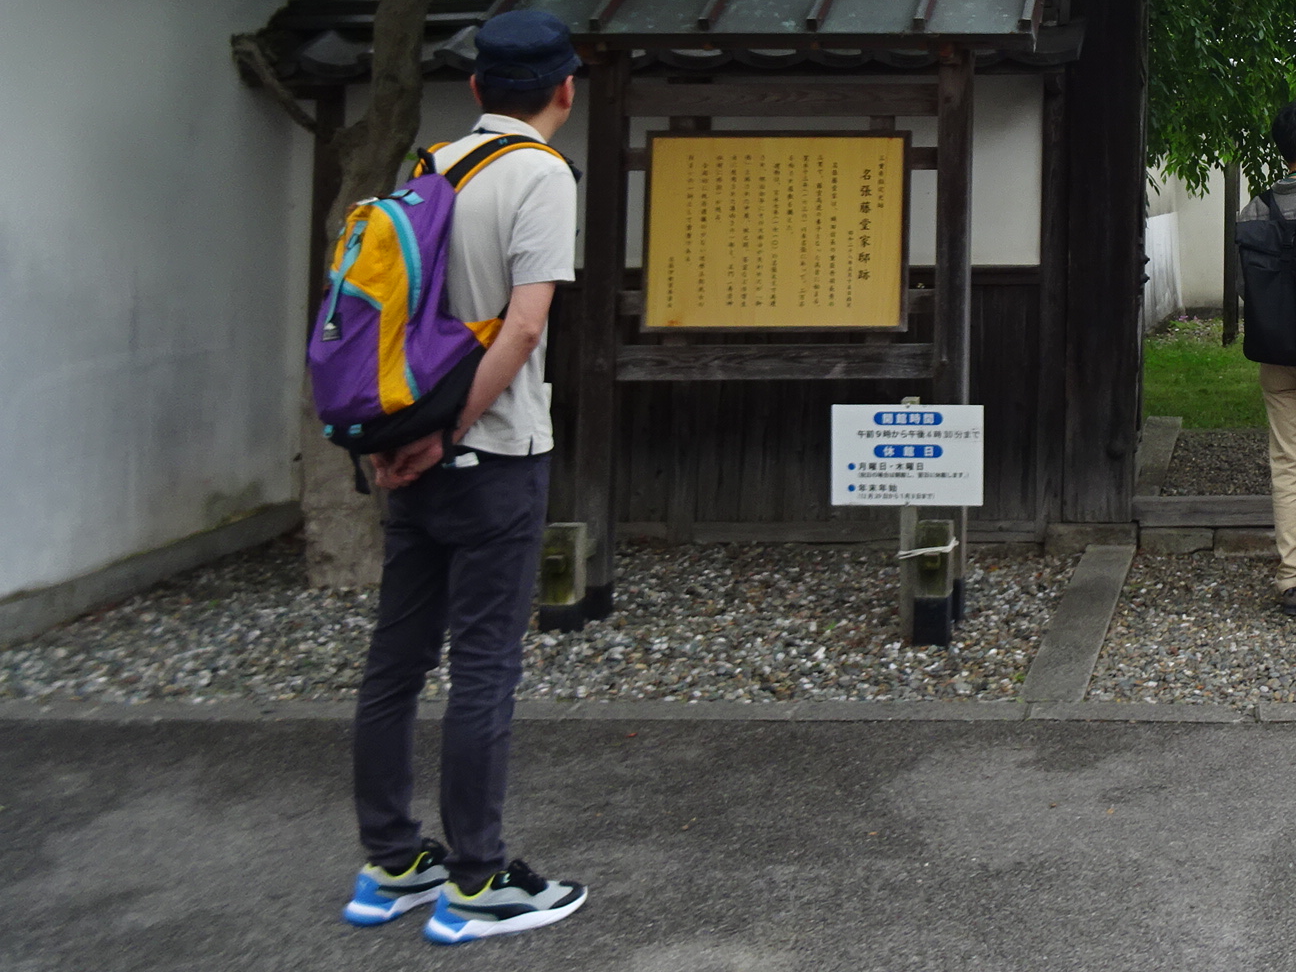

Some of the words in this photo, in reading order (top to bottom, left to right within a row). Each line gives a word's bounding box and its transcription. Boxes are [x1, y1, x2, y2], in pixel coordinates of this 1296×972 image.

[857, 168, 872, 281] 名張藤堂家邸跡
[881, 413, 935, 425] 開館時間
[882, 446, 935, 457] 休館日
[858, 462, 924, 471] 月曜日・木曜日
[858, 484, 898, 493] 年末年始
